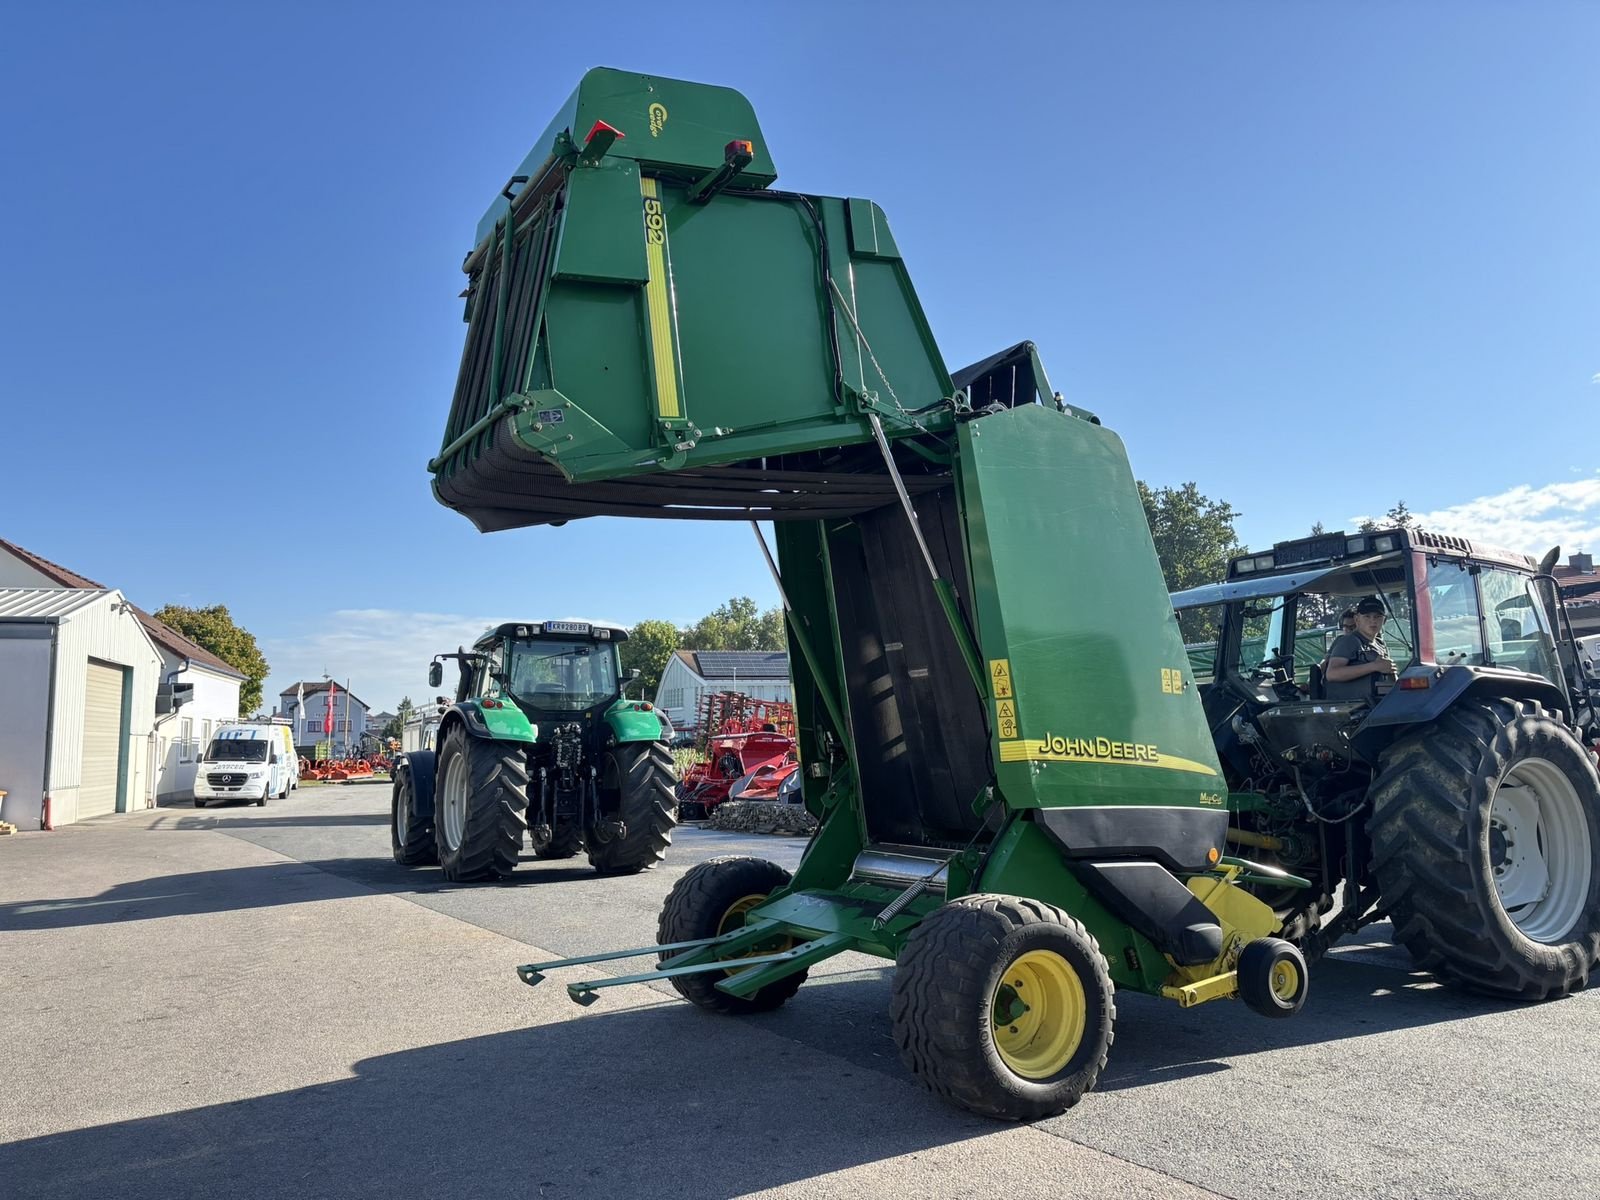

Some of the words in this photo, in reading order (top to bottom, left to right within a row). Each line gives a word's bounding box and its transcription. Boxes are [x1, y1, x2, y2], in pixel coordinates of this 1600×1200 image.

[644, 198, 665, 245] 592
[1039, 731, 1094, 757] JOHN
[1095, 736, 1160, 762] DEERE
